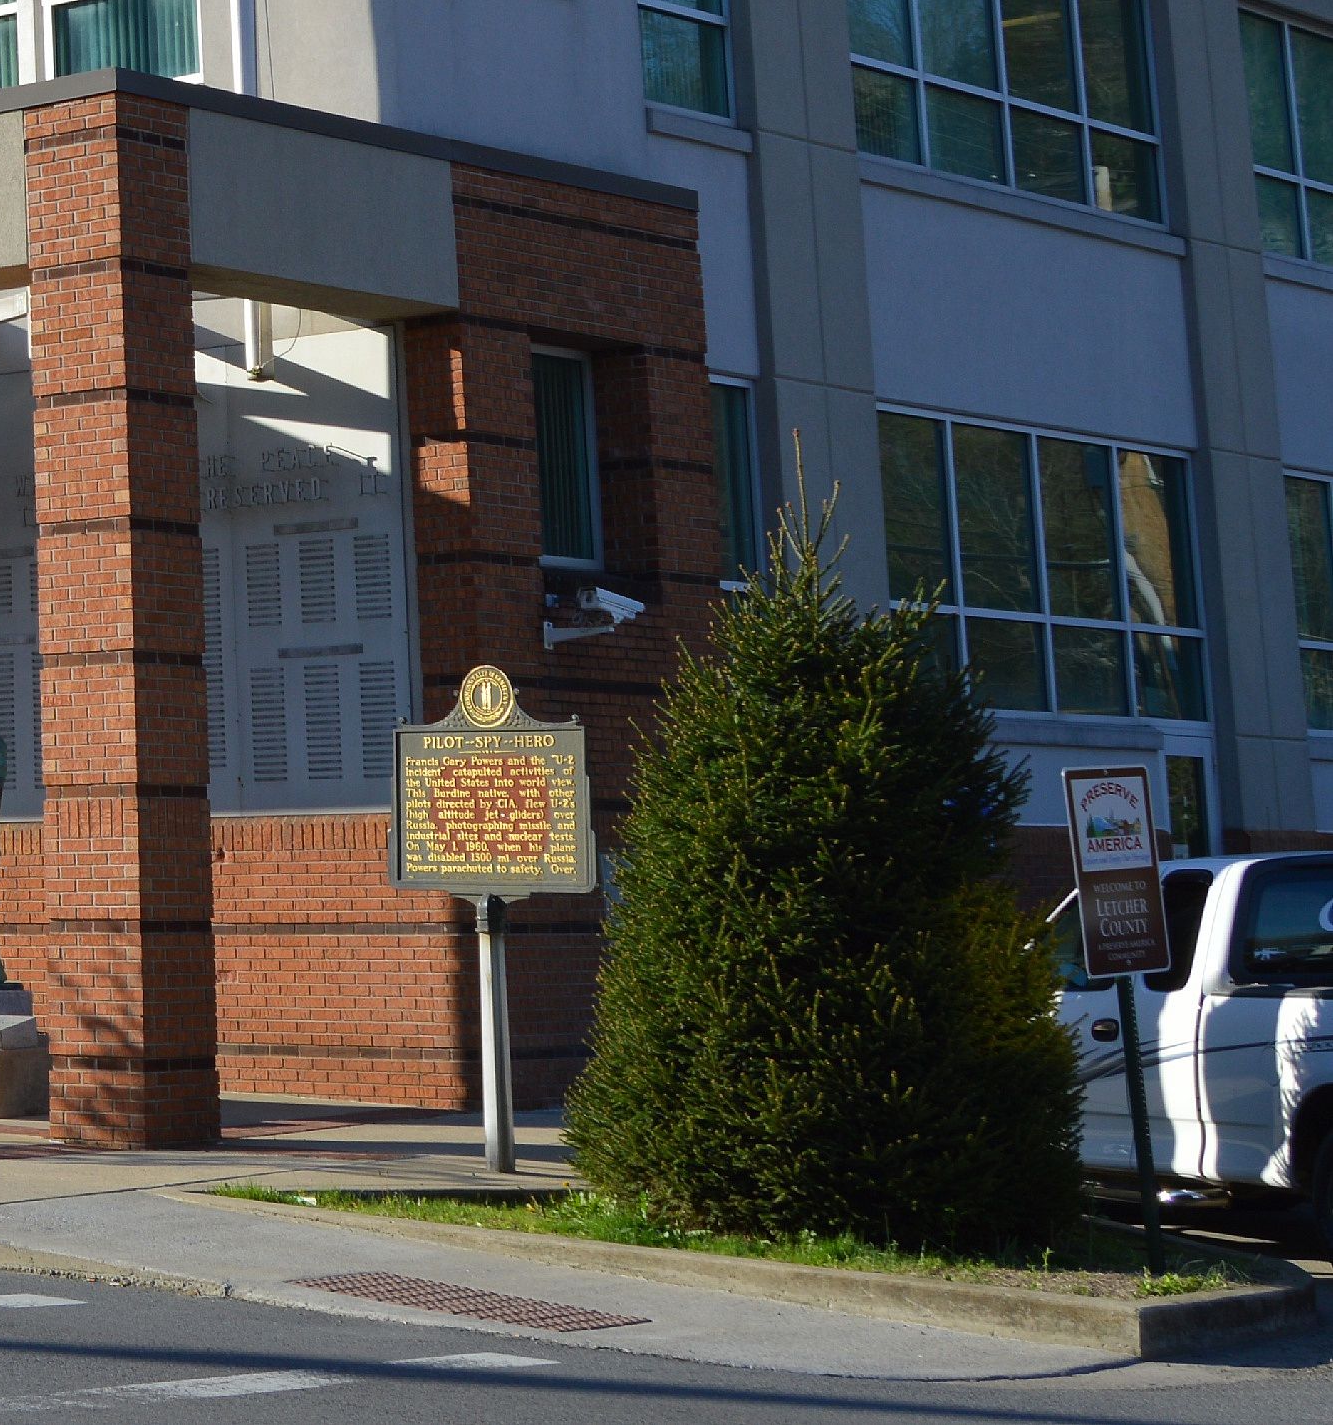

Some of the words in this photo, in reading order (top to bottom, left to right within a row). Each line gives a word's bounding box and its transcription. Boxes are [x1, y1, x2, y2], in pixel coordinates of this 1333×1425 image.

[405, 756, 439, 765] Francis
[442, 756, 467, 767] Gary
[471, 756, 503, 765] Powers
[507, 756, 526, 765] and
[531, 756, 546, 765] the
[453, 767, 503, 778] catapulted
[510, 767, 555, 776] activities
[563, 767, 575, 776] of
[406, 778, 420, 787] the
[425, 778, 455, 787] United
[460, 778, 490, 787] States
[494, 778, 514, 787] into
[519, 778, 546, 787] world
[406, 789, 426, 797] This
[434, 789, 471, 797] Burdine
[519, 789, 541, 797] with
[548, 789, 575, 797] other
[1081, 782, 1138, 812] PRESERVE
[406, 799, 431, 810] pilots
[436, 799, 476, 808] directed
[479, 799, 492, 810] by
[525, 799, 546, 808] flew
[438, 810, 476, 819] altitude
[446, 821, 514, 832] photographing
[519, 821, 552, 830] missile
[557, 821, 576, 830] and
[406, 832, 451, 840] industrial
[457, 832, 479, 840] sites
[484, 832, 502, 840] and
[508, 832, 544, 840] nuclear
[406, 842, 420, 851] On
[426, 842, 446, 853] May
[497, 842, 522, 851] when
[528, 842, 543, 851] his
[549, 842, 576, 853] plane
[1088, 836, 1142, 852] AMERICA
[428, 853, 466, 862] disabled
[471, 853, 492, 862] 1300
[406, 864, 438, 873] Powers
[440, 864, 493, 875] parachuted
[496, 864, 507, 873] to
[1094, 882, 1134, 893] WELCOME
[1096, 898, 1148, 916] LETCHER
[1101, 918, 1147, 936] COUNTY
